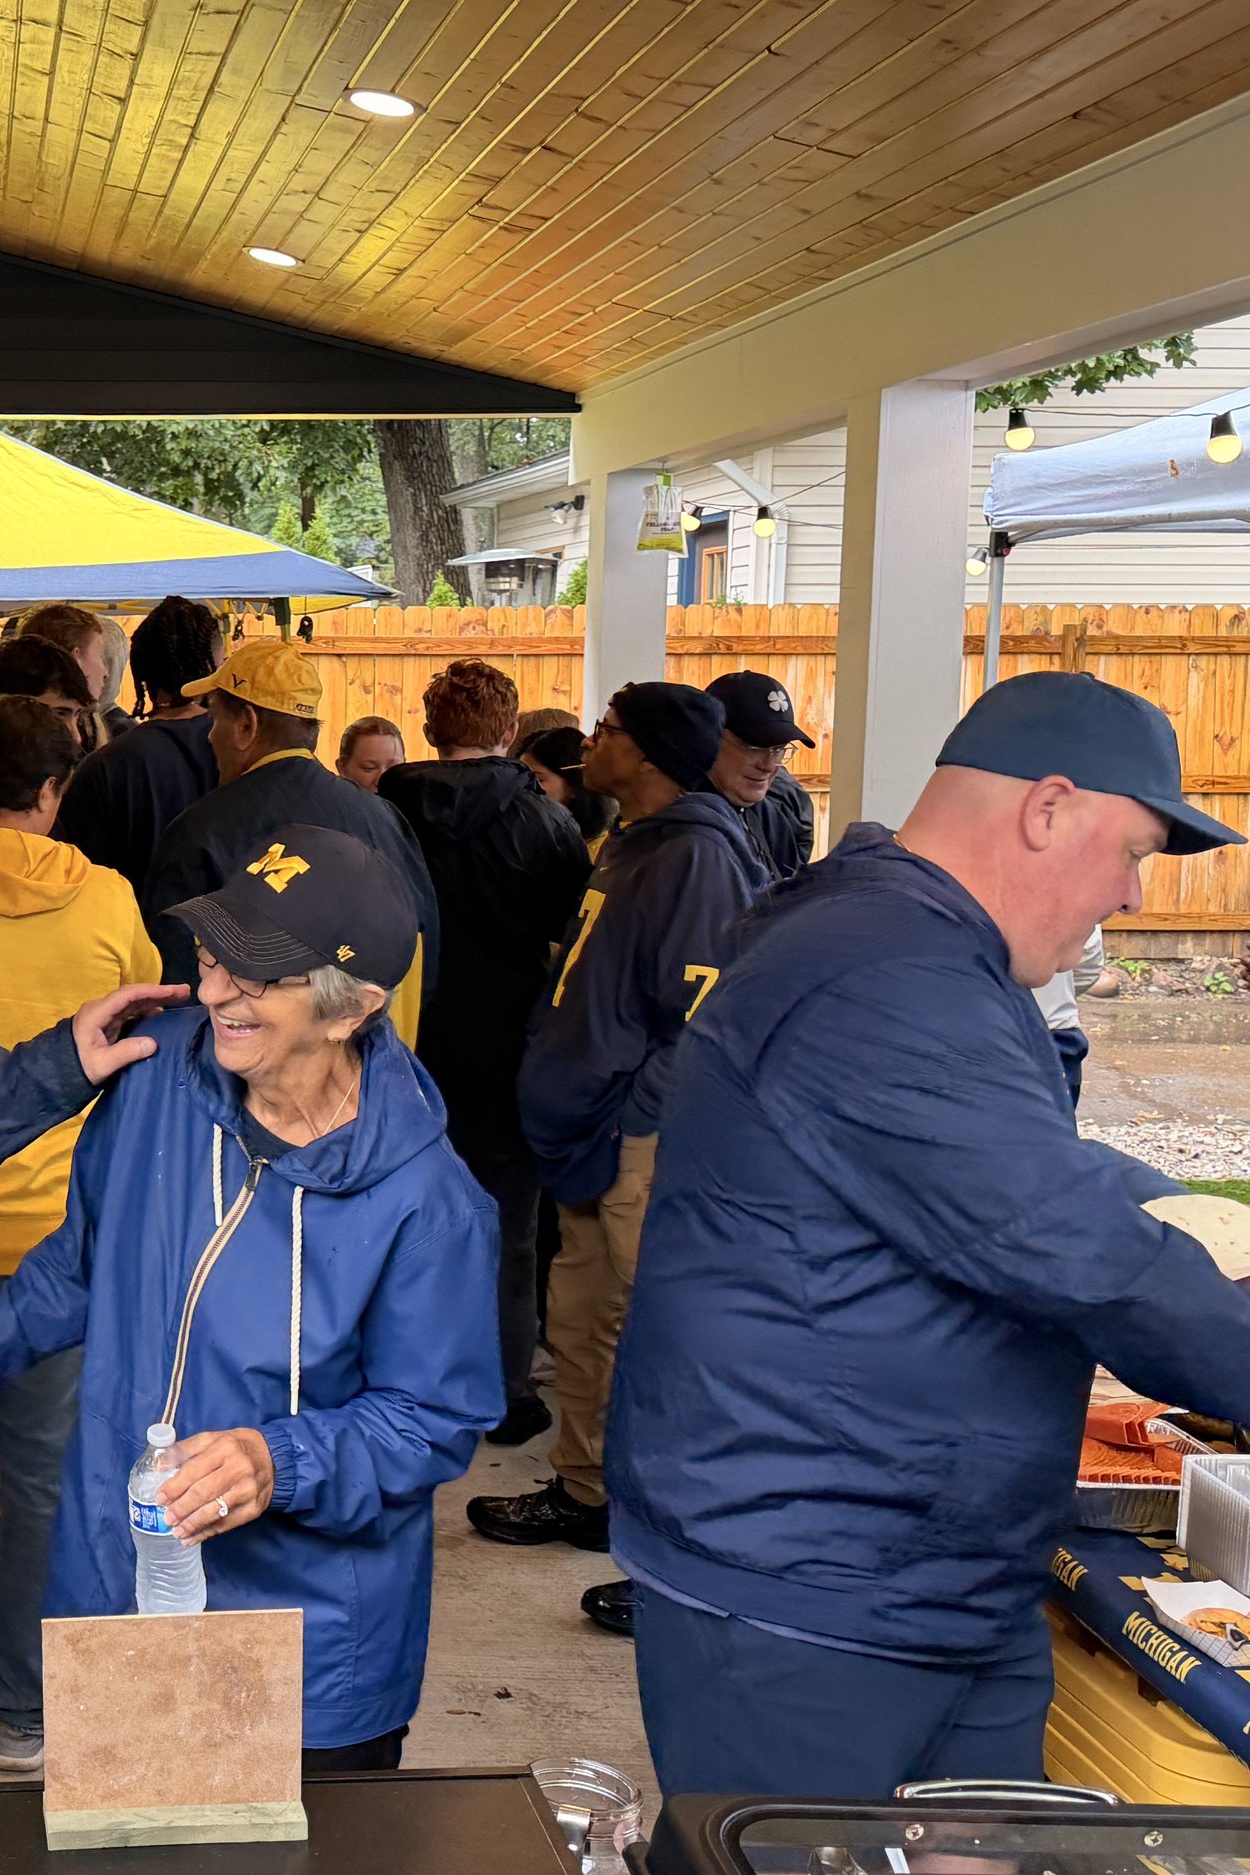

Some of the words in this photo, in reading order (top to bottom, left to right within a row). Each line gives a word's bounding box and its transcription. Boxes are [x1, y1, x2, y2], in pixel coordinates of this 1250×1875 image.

[551, 888, 607, 1008] 7
[683, 964, 720, 1022] 7
[1051, 1547, 1089, 1591] IGAN
[1121, 1611, 1203, 1684] MICHIGAN
